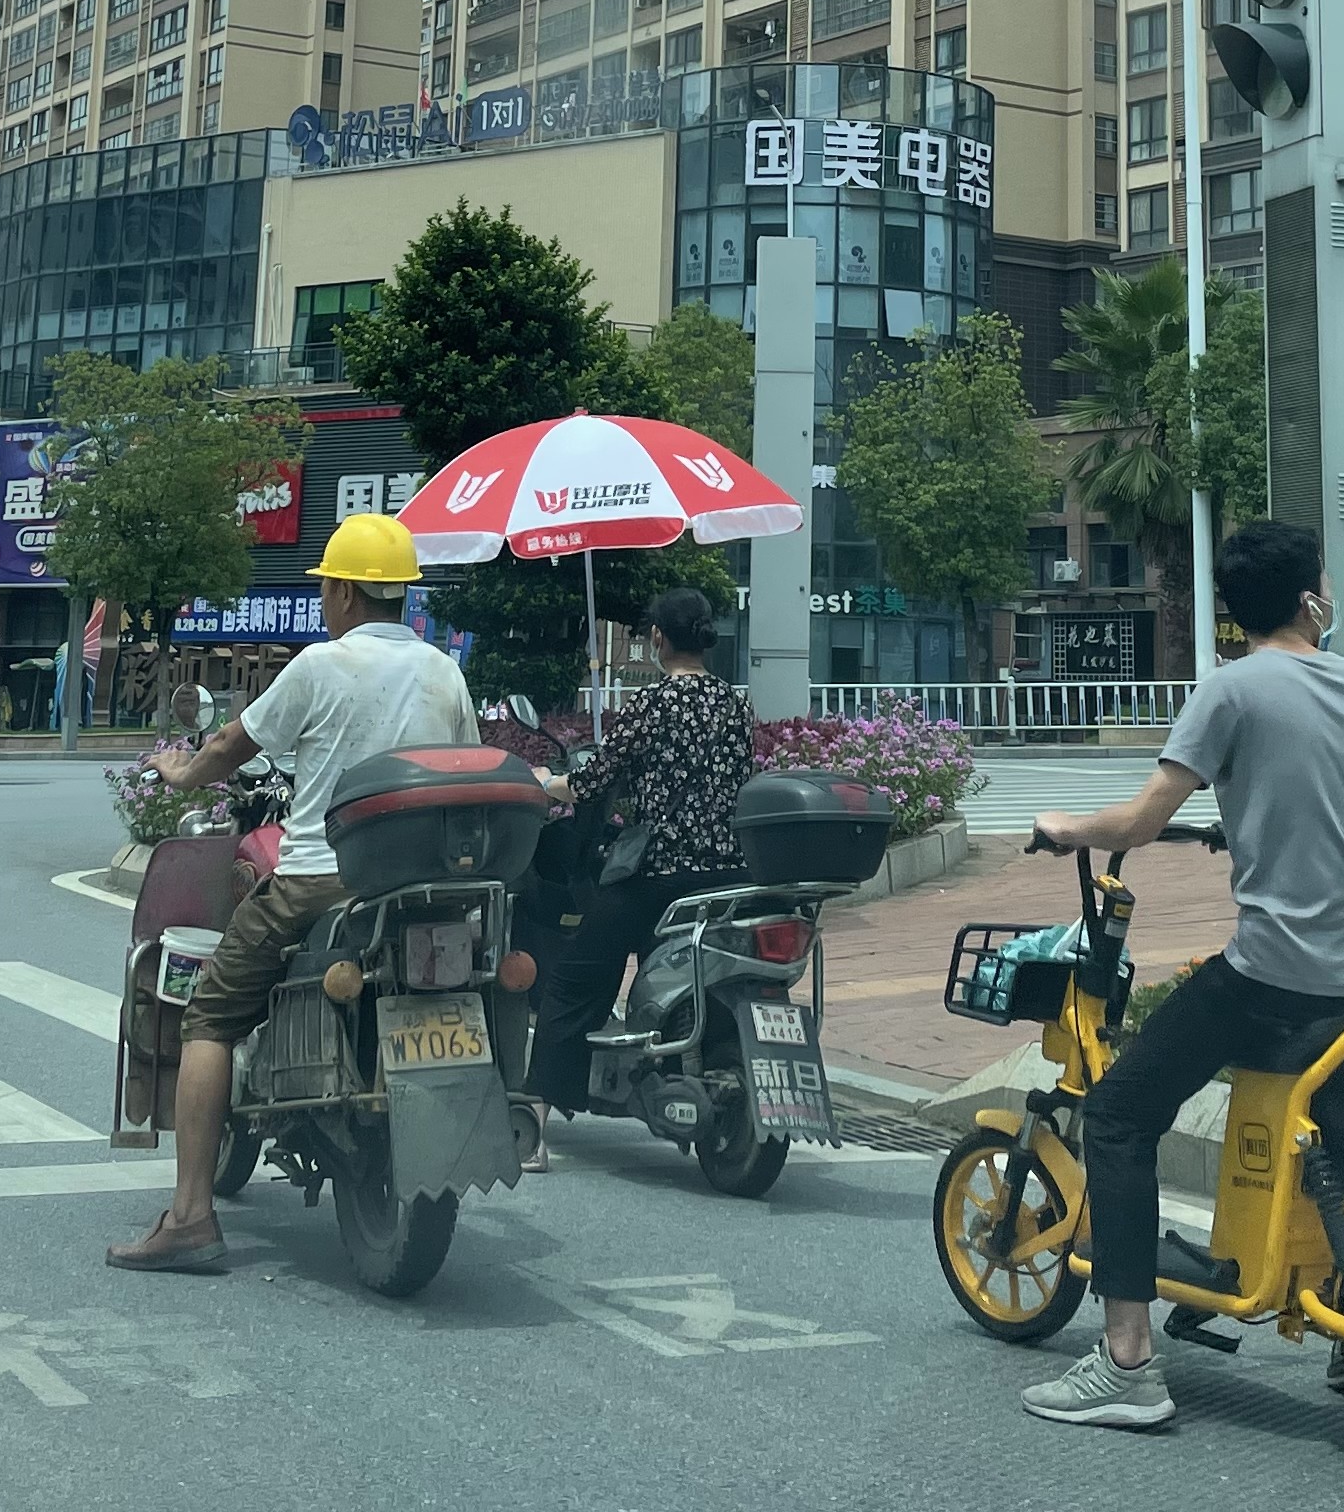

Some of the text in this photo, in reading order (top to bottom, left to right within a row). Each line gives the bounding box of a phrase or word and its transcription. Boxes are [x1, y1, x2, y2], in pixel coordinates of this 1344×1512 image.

[745, 119, 992, 208] 国美电器
[390, 1029, 483, 1064] WY063
[761, 1026, 803, 1042] 14412
[750, 1058, 822, 1091] 新日
